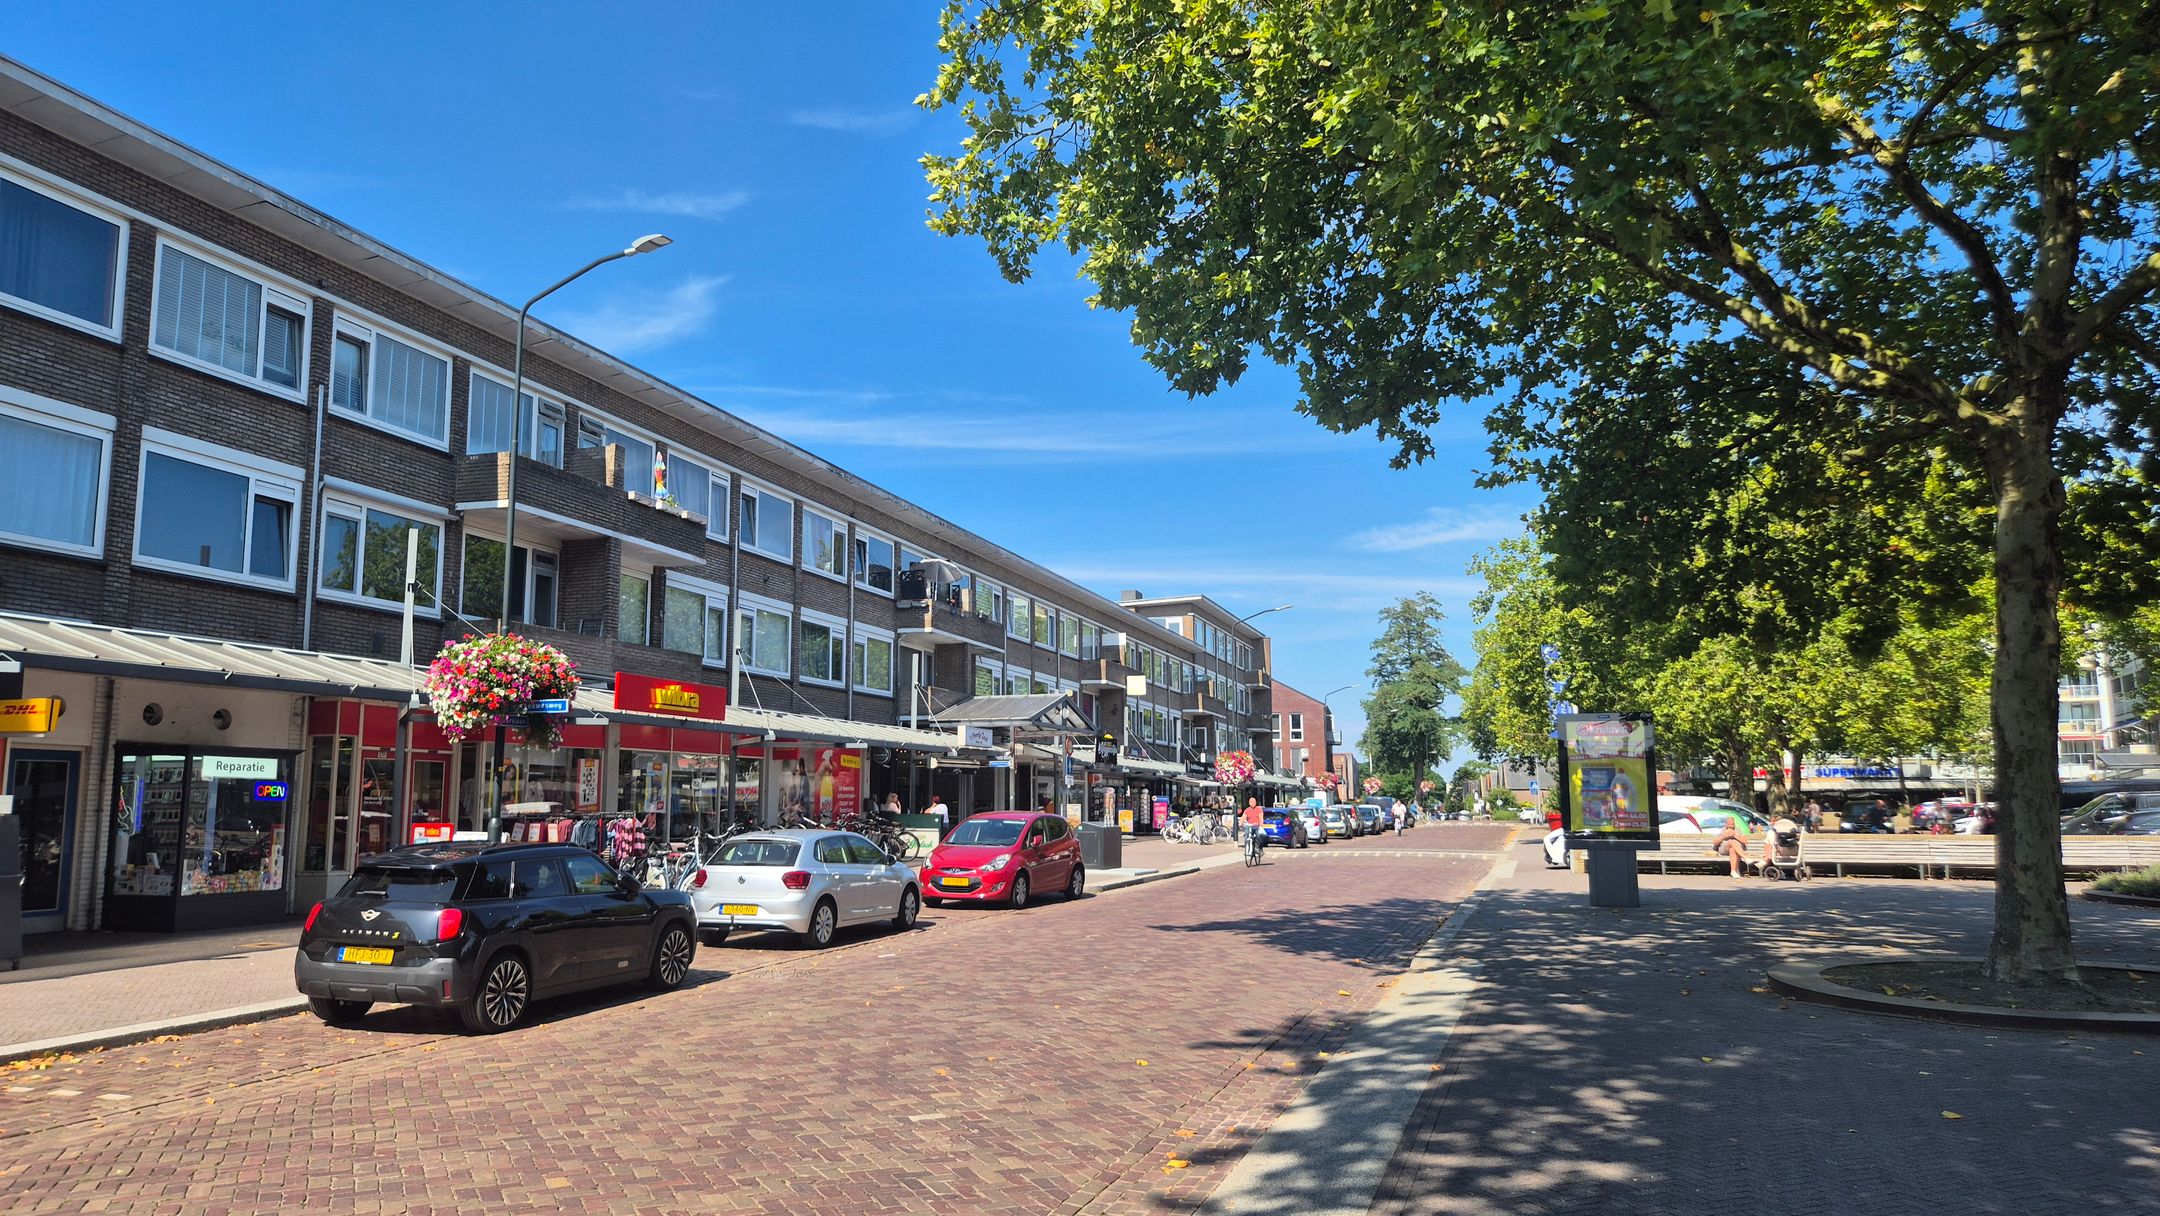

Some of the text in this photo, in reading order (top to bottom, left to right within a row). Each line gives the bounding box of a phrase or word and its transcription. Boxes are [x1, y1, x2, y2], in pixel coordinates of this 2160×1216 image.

[4, 704, 37, 715] DHL
[216, 761, 265, 773] Reparatie
[256, 785, 285, 797] OPEN
[342, 929, 390, 937] ACEMAN
